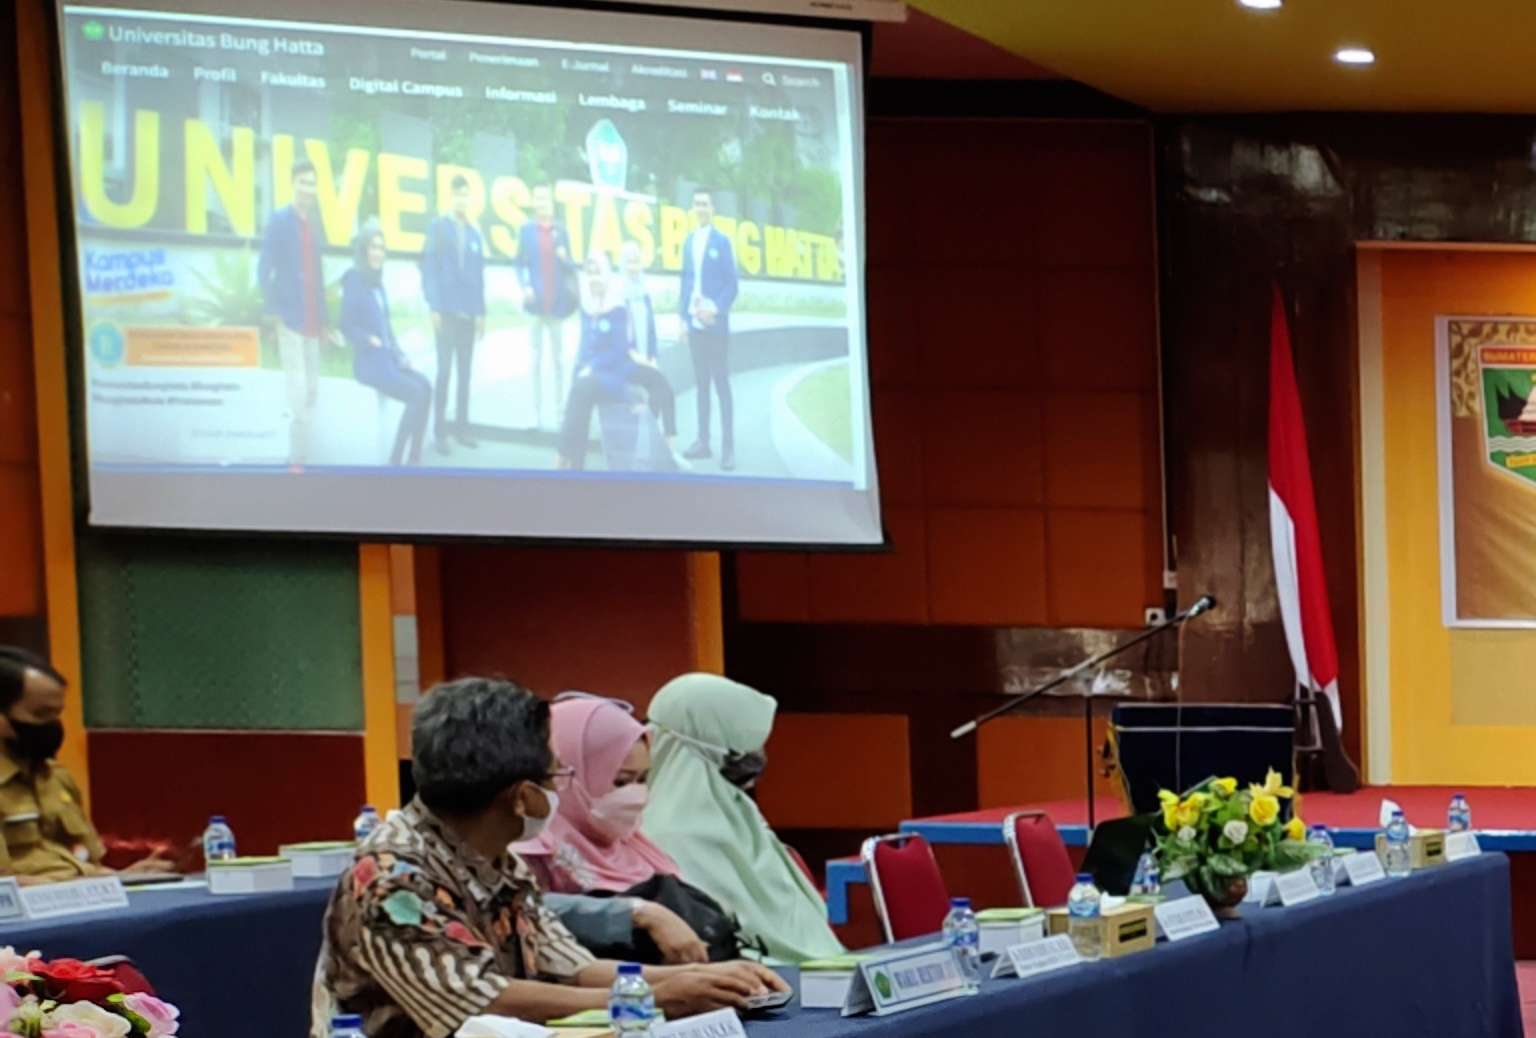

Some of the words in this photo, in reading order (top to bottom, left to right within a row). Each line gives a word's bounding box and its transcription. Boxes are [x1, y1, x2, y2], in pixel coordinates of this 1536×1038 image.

[108, 26, 215, 50] Universitas
[220, 34, 269, 55] Bung
[273, 38, 324, 55] Hatta
[411, 47, 447, 61] Portal
[102, 61, 169, 79] Beranda
[194, 66, 237, 83] Profil
[261, 70, 326, 89] Fakultas
[349, 76, 398, 96] Digital
[402, 81, 463, 99] Campus
[485, 86, 557, 103] Informasi
[579, 93, 646, 112] Lembaga
[667, 99, 727, 116] Seminar
[749, 104, 801, 121] Kontak
